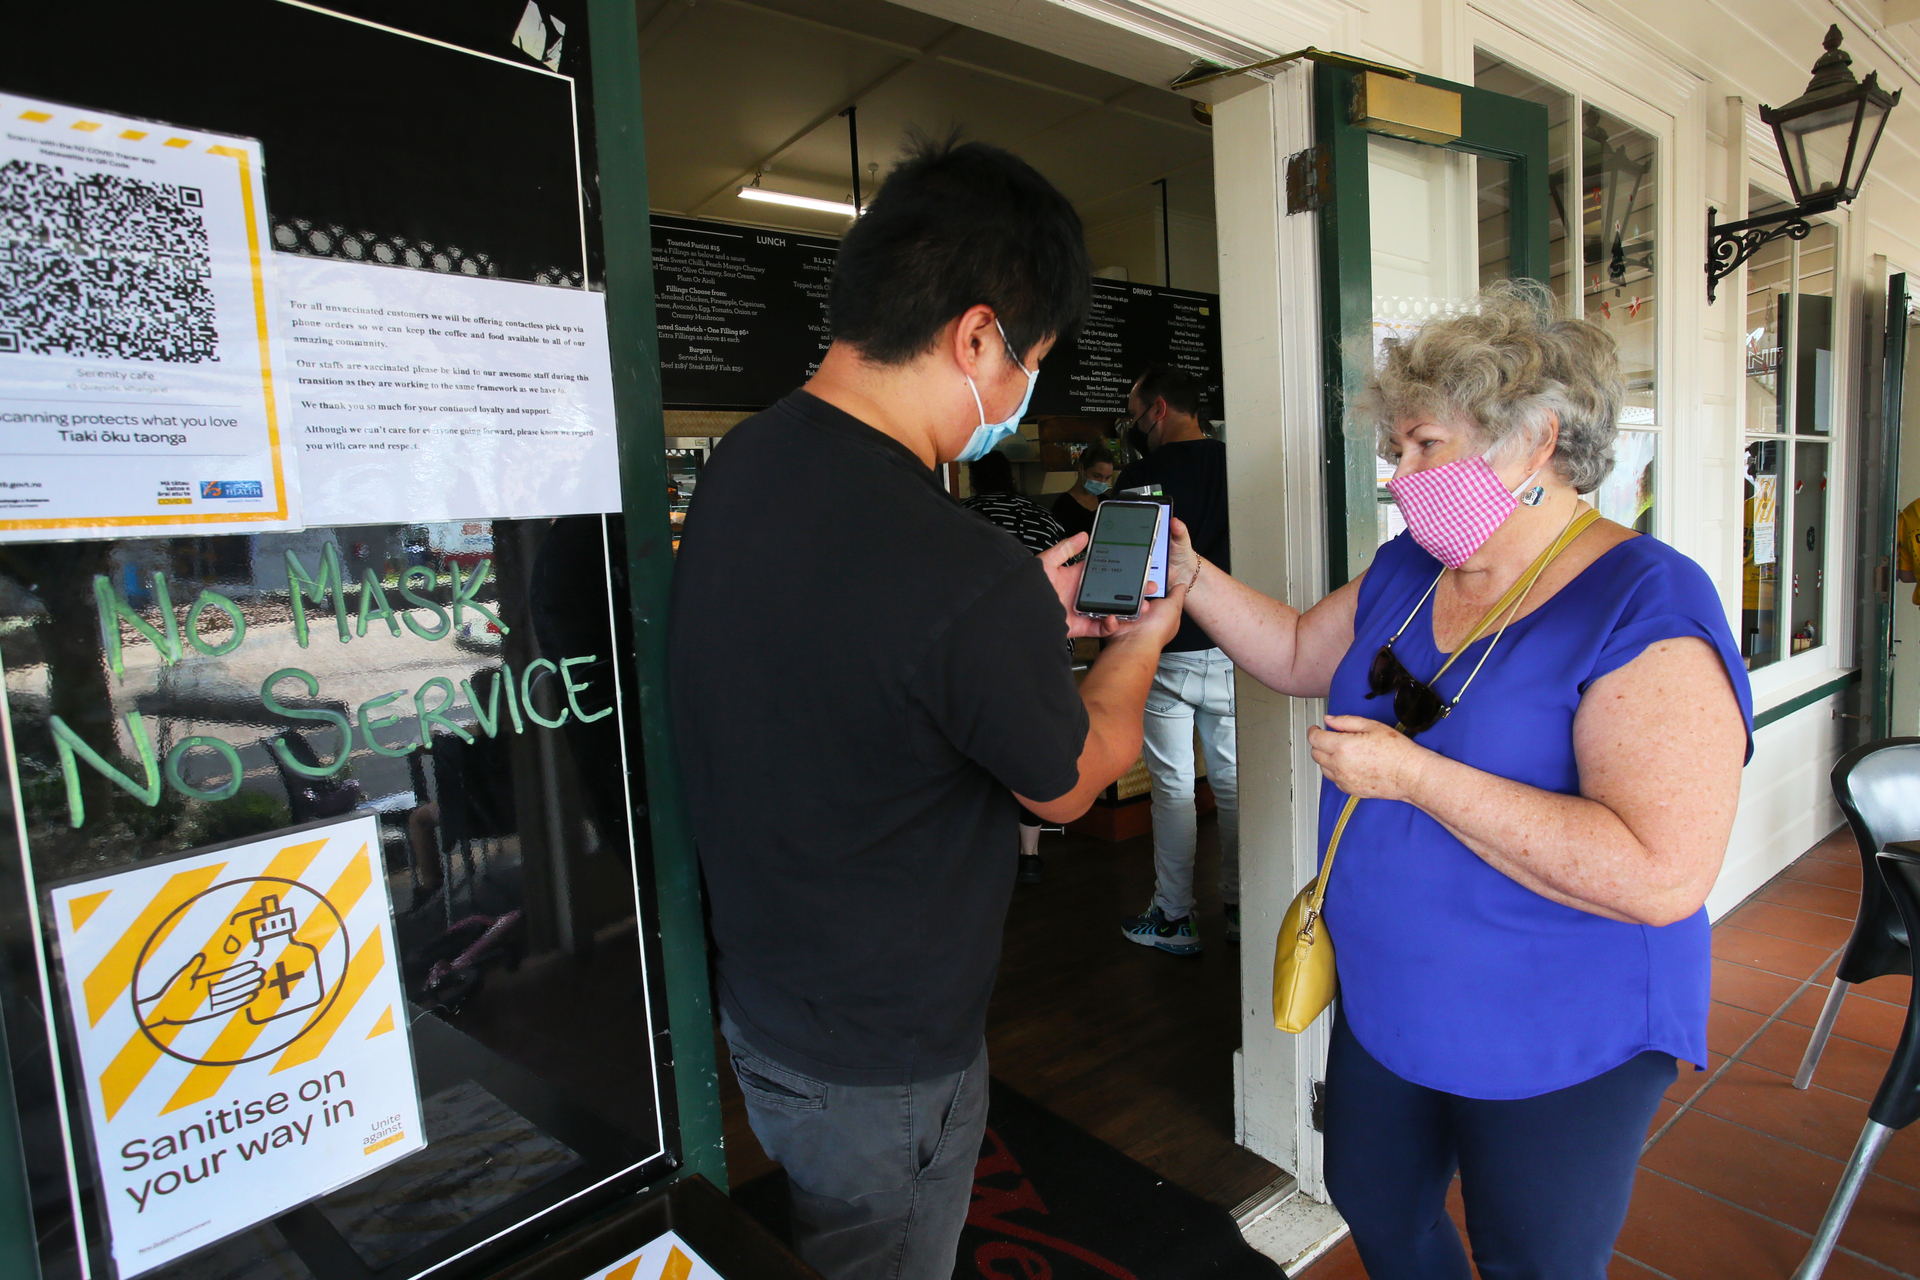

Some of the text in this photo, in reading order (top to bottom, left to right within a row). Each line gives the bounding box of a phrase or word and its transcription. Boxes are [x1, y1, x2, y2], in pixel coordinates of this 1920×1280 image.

[667, 239, 690, 247] Toasted
[691, 242, 709, 250] Panini
[757, 236, 786, 246] LUNCH
[669, 248, 689, 256] Fillings
[723, 263, 742, 271] Mango
[743, 265, 765, 274] Chutney
[666, 286, 688, 294] Fillings
[1133, 288, 1152, 296] DRINKS
[290, 300, 307, 309] For
[326, 305, 384, 316] unvaccinated
[387, 310, 429, 319] customers
[474, 317, 503, 326] offering
[506, 320, 543, 329] contactless
[672, 312, 694, 320] Creamy
[292, 319, 321, 327] phone
[325, 321, 354, 329] orders
[406, 326, 425, 336] keep
[445, 330, 467, 338] coffee
[508, 335, 539, 343] available
[294, 336, 388, 348] amazing community.
[77, 368, 154, 380] Serenity cafe
[297, 360, 315, 368] Our
[319, 361, 343, 369] staffs
[365, 364, 409, 372] vaccinated
[413, 366, 438, 375] please
[552, 373, 574, 381] during
[299, 377, 343, 385] transition
[358, 379, 376, 388] they
[395, 381, 429, 390] working
[477, 384, 517, 392] framework
[479, 406, 504, 414] loyalty
[73, 414, 138, 427] protects
[142, 415, 177, 427] what
[183, 417, 206, 428] you
[210, 415, 237, 427] love
[59, 430, 186, 445] Tiaki ōku taonga
[305, 425, 347, 434] Although
[364, 426, 386, 434] can't
[409, 426, 420, 434] for
[483, 428, 515, 436] forward,
[517, 429, 538, 437] please
[306, 443, 323, 451] you
[260, 654, 614, 777] SERVICE
[121, 1069, 346, 1171] Sanitise on
[371, 1113, 401, 1132] Unite
[363, 1122, 403, 1144] against
[363, 1131, 404, 1156] COVID-19
[126, 1099, 354, 1213] your way in
